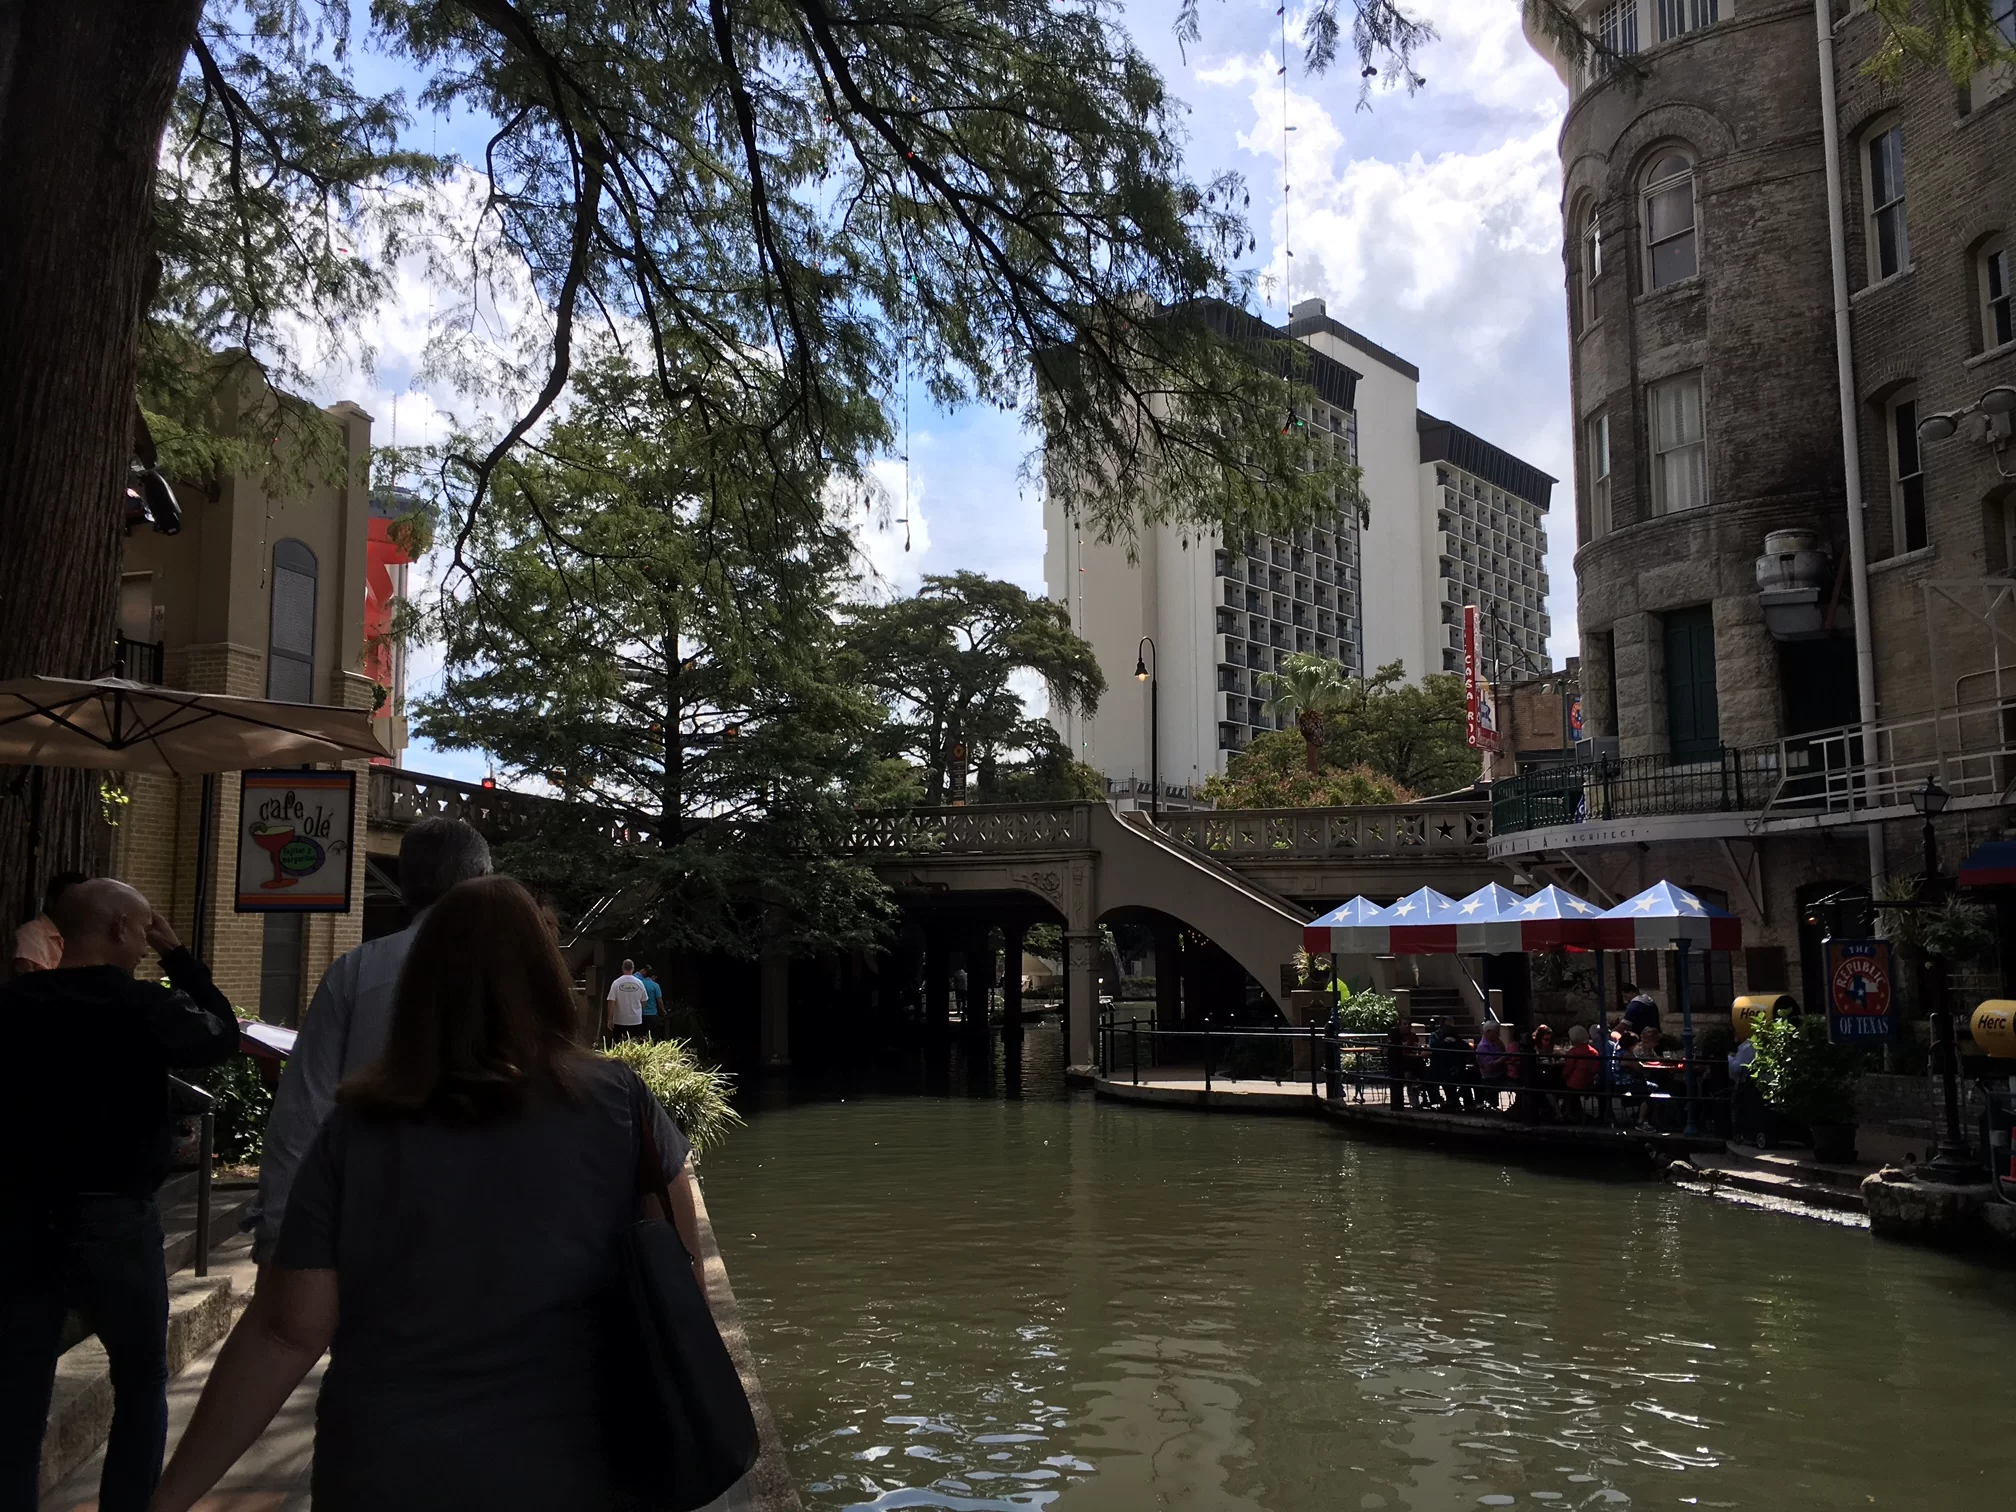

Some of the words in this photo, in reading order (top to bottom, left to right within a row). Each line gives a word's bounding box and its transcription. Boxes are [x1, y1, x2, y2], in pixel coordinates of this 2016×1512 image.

[1464, 655, 1474, 700] CASA
[1467, 711, 1476, 745] RIO
[304, 806, 334, 839] olé
[1848, 945, 1870, 954] THE
[1836, 960, 1887, 988] REPUBLIC
[1740, 1007, 1767, 1019] Her
[1978, 1014, 2007, 1029] Herc
[1840, 1017, 1854, 1035] OF
[1856, 1016, 1889, 1035] TEXAS
